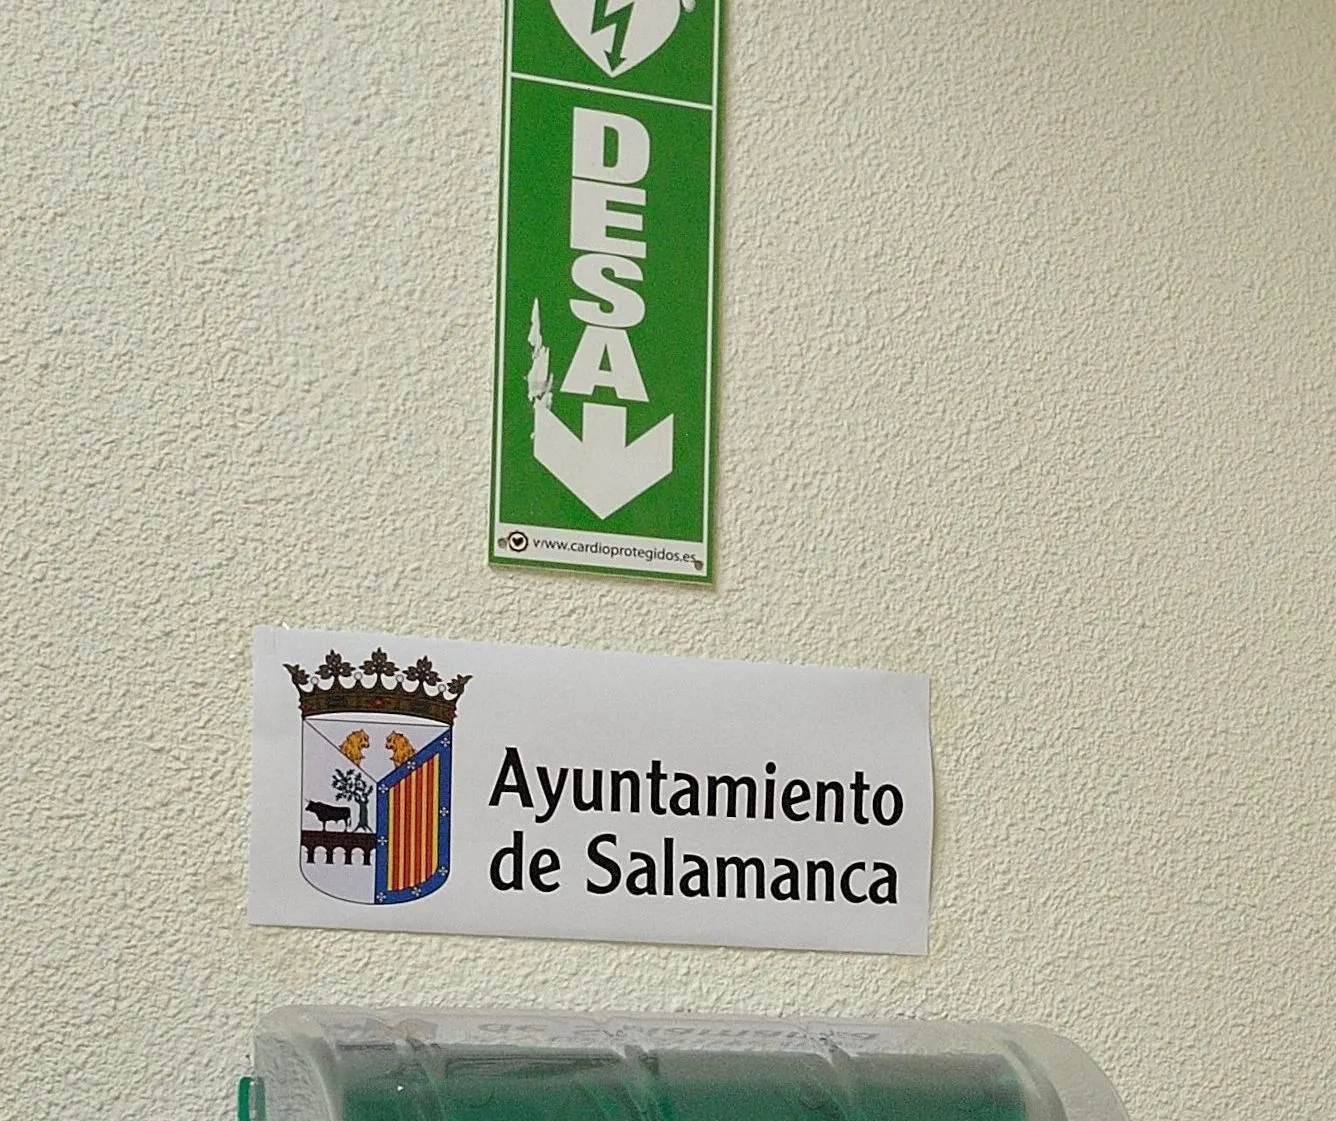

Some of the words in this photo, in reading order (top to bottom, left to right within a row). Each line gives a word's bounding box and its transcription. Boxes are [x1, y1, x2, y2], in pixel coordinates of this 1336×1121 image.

[560, 106, 650, 403] DESA
[533, 537, 697, 563] www.cardioprotegidos.es
[488, 746, 905, 826] Ayuntamiento
[488, 830, 561, 893] de
[586, 833, 899, 904] Salamanca
